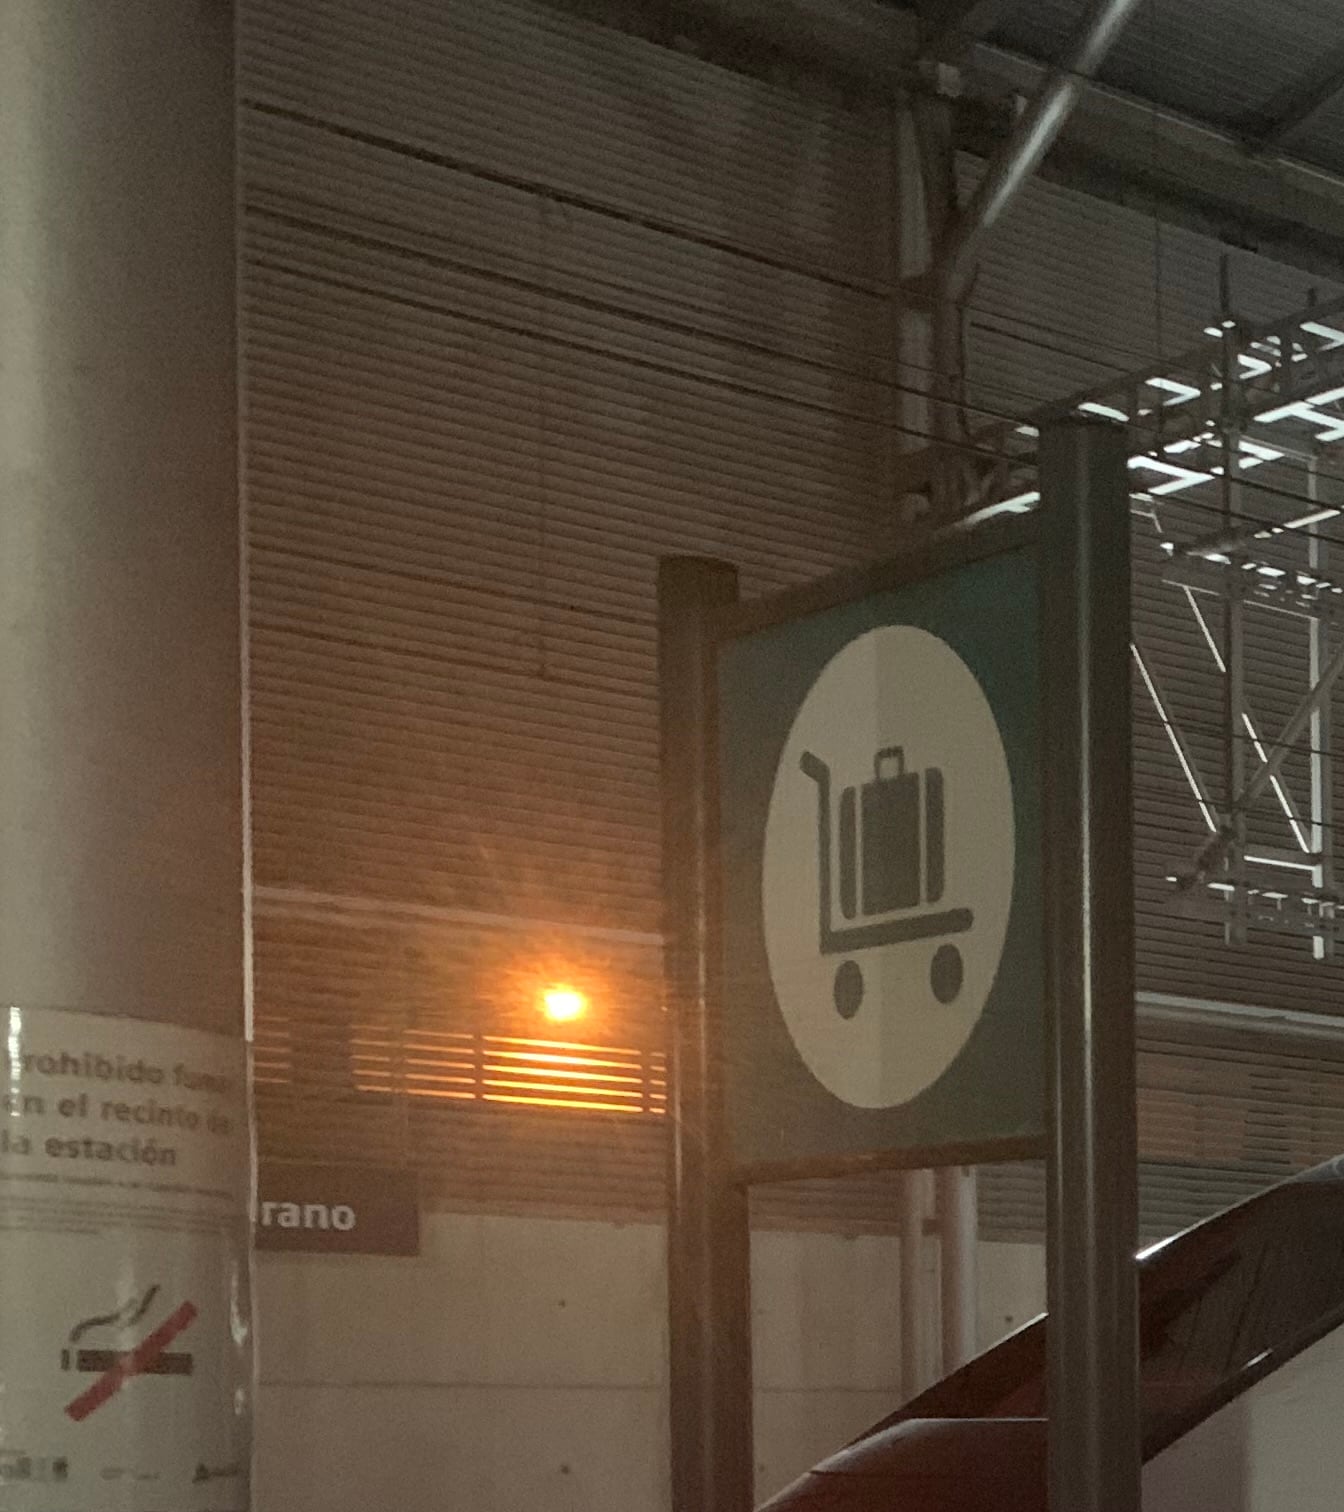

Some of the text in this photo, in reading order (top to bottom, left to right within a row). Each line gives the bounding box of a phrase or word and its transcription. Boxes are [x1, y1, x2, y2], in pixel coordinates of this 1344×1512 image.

[58, 1092, 88, 1118] el
[101, 1098, 200, 1130] recinto
[45, 1136, 176, 1167] estación
